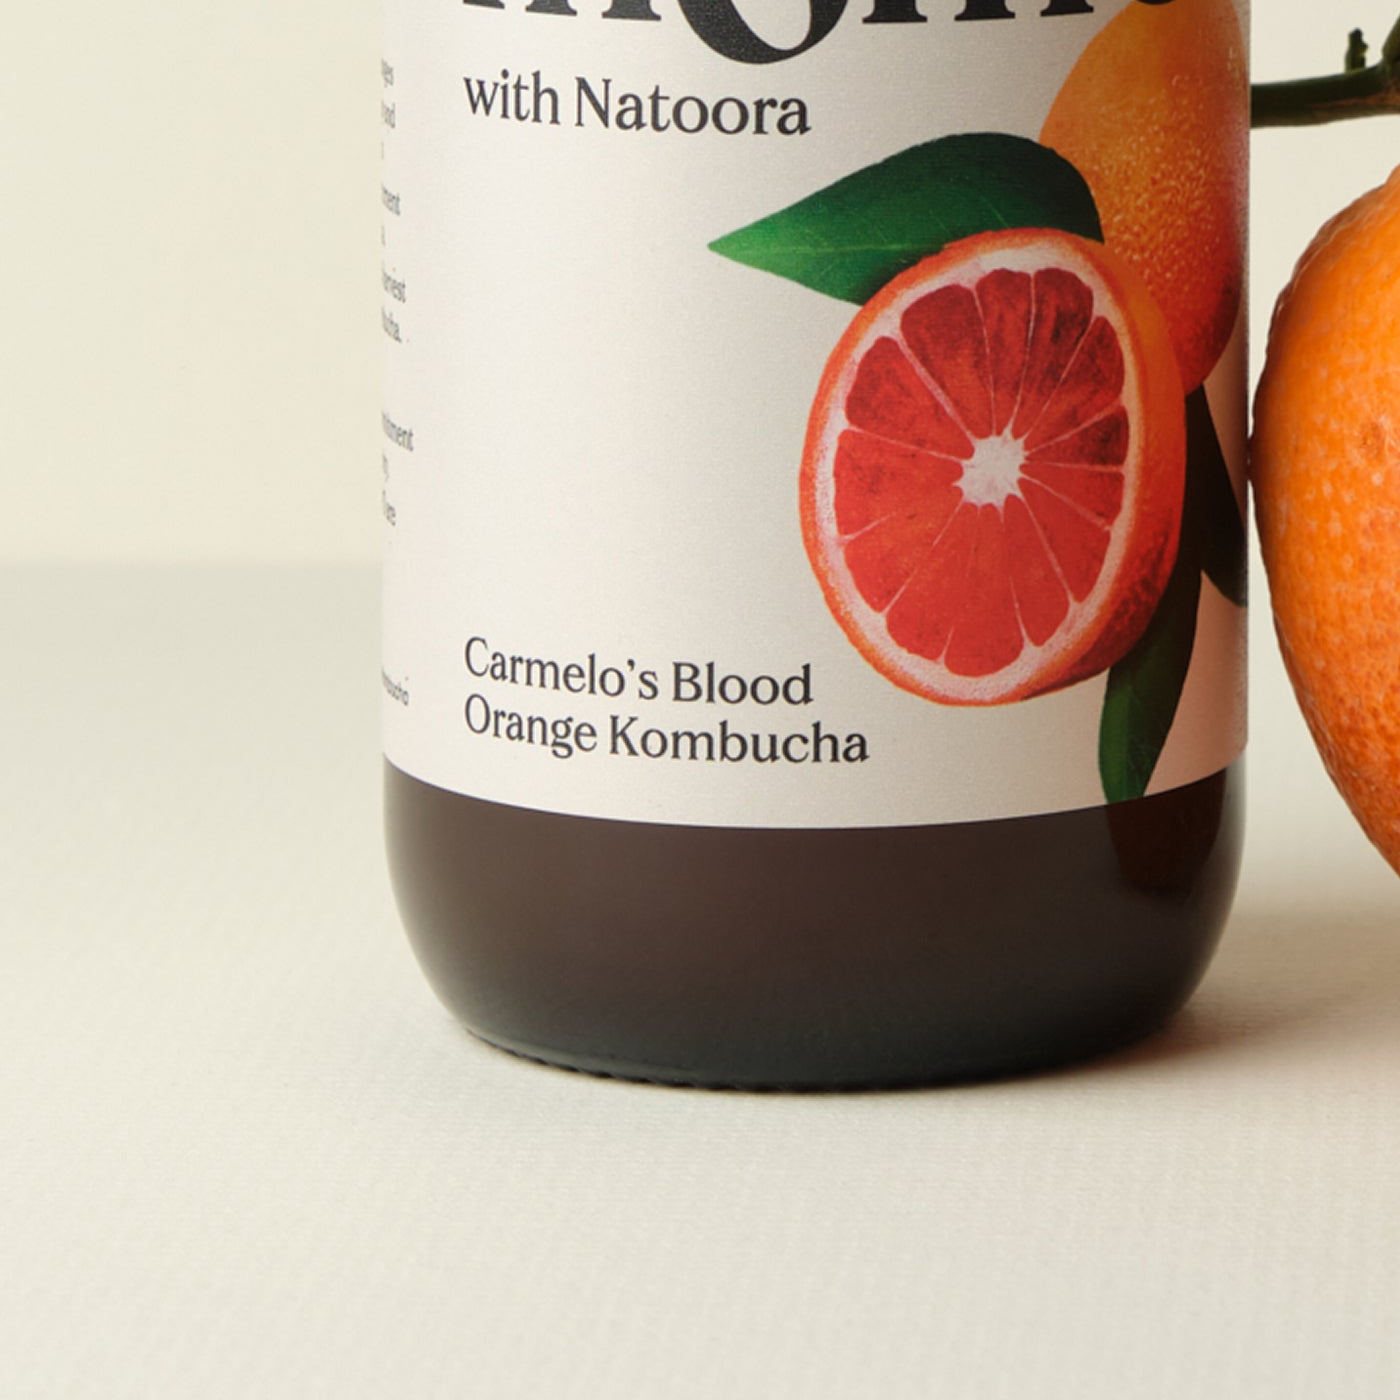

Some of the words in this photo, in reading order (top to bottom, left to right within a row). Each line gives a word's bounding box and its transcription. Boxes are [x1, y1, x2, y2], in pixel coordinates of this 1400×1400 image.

[464, 69, 559, 126] with
[575, 77, 811, 136] Natoora
[465, 636, 659, 701] Carmelo’s
[672, 661, 814, 705] Blood
[465, 693, 598, 759] Orange
[609, 714, 870, 763] Kombucha
